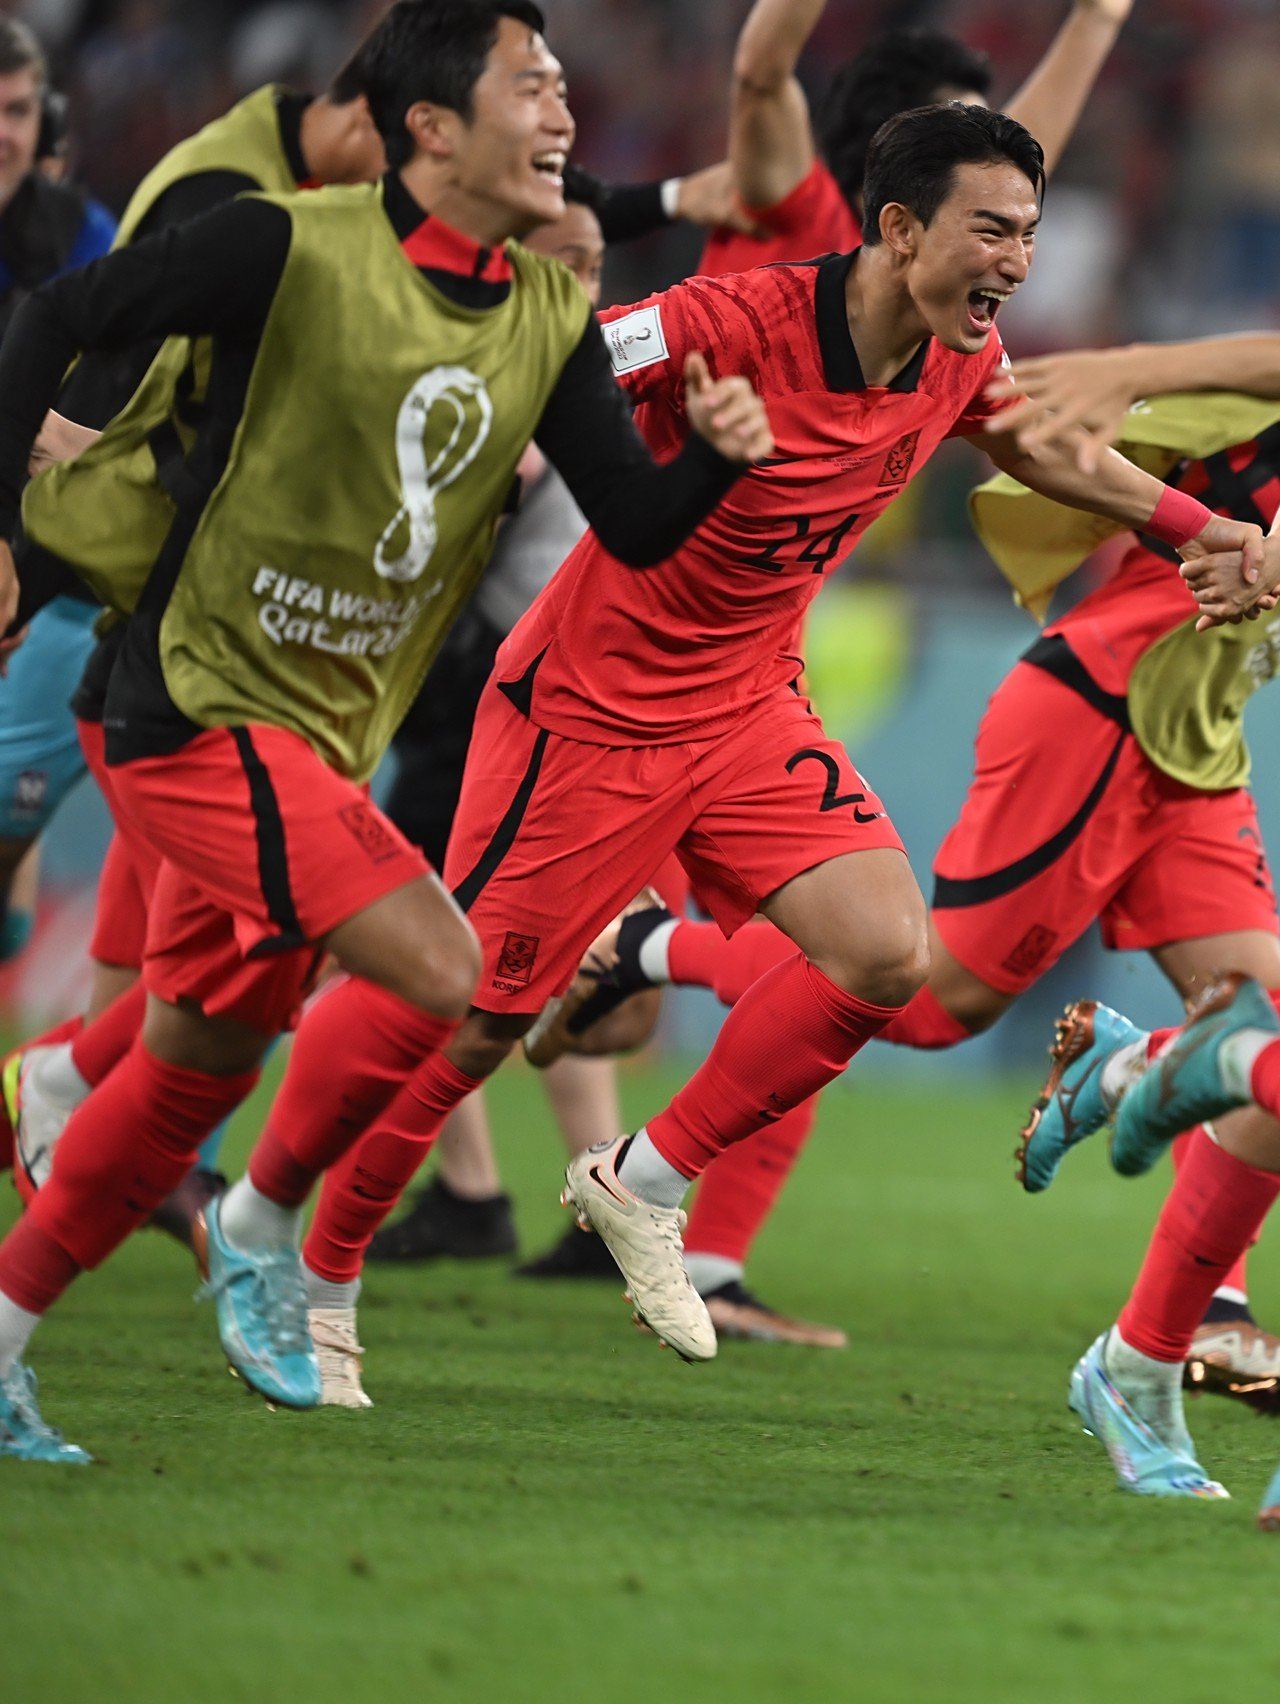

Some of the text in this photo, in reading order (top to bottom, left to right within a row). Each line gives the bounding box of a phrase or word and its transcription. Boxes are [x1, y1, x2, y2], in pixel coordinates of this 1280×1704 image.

[738, 513, 860, 574] 24
[252, 565, 324, 614] FIFA
[784, 748, 872, 812] 2
